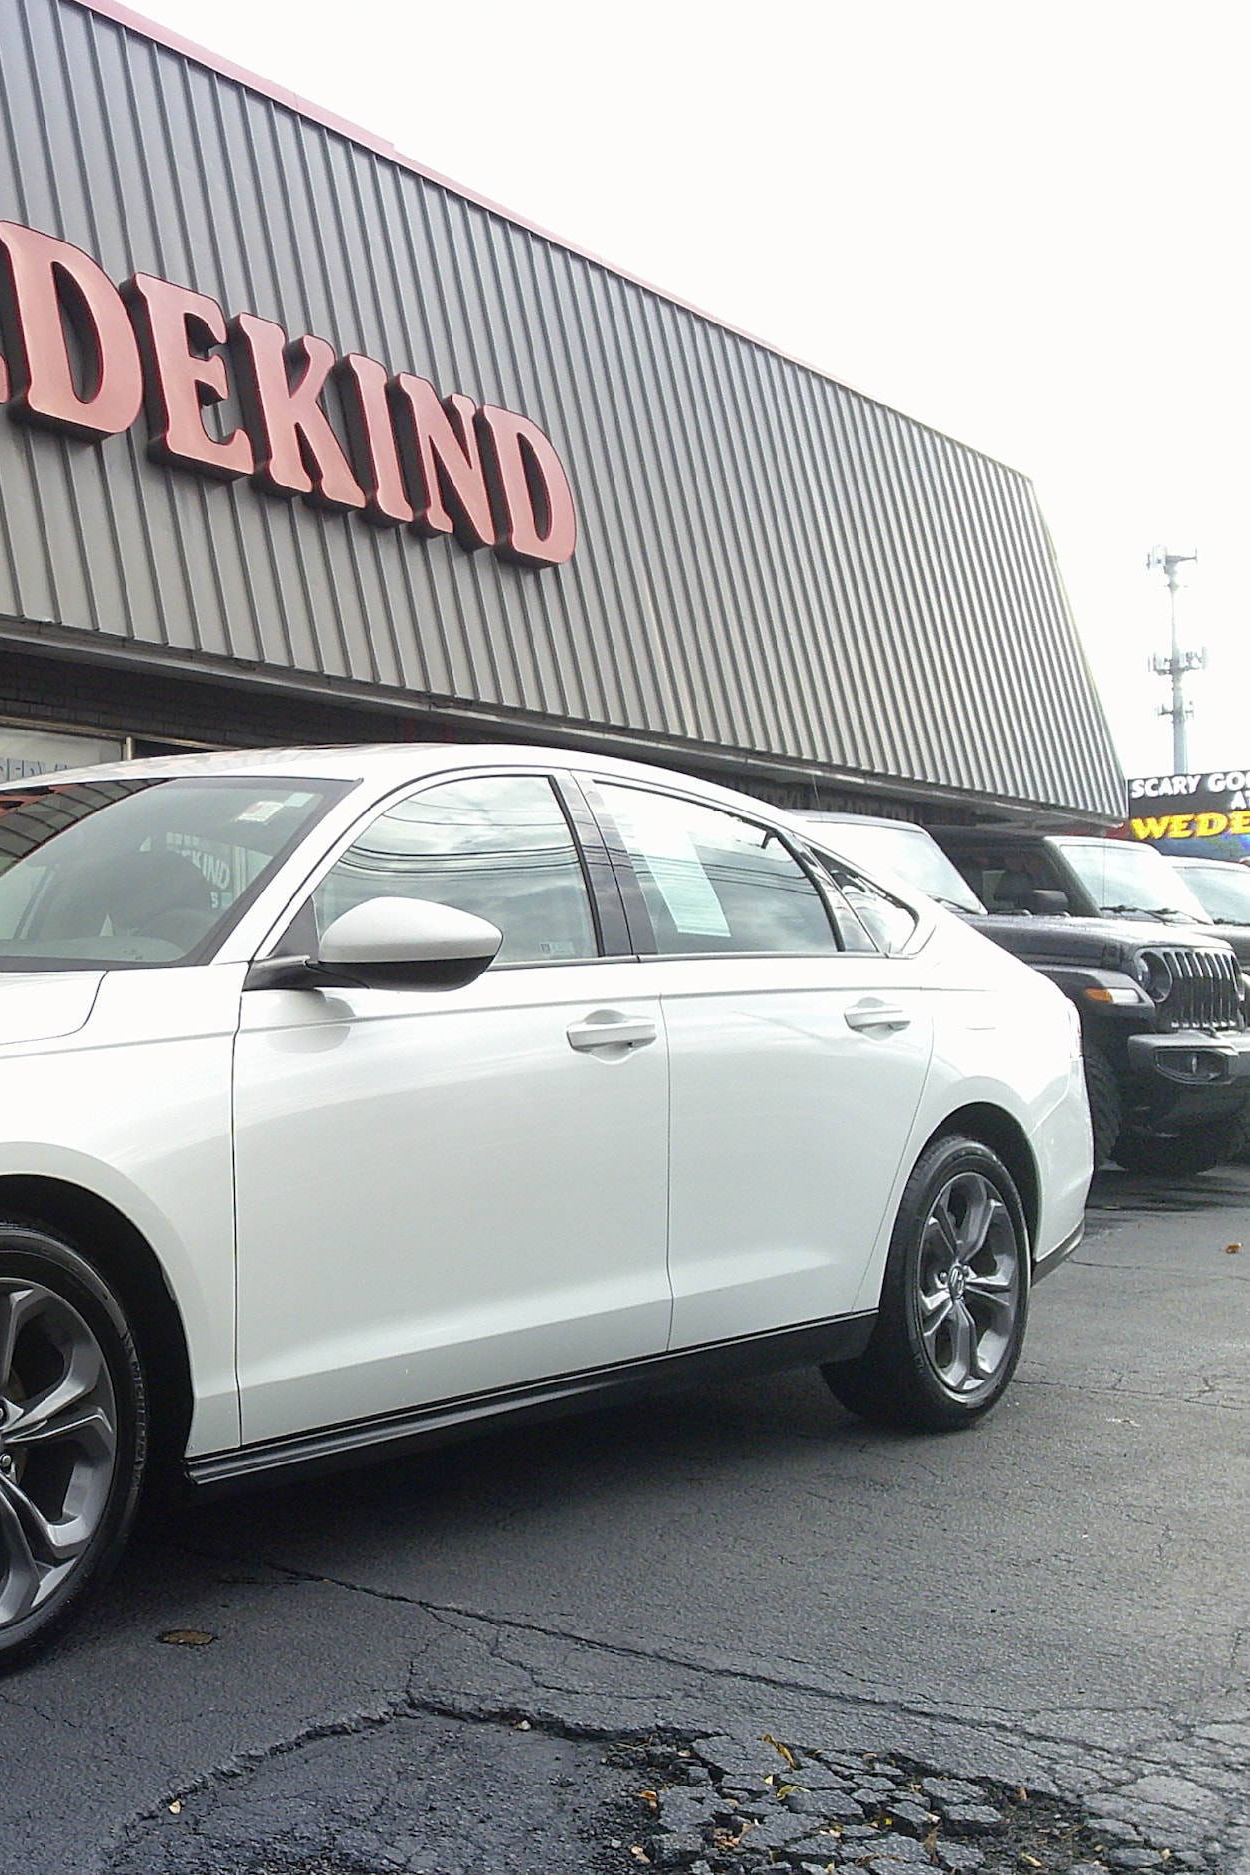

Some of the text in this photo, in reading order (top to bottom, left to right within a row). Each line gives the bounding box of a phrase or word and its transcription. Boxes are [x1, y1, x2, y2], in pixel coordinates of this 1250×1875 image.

[1131, 771, 1250, 799] SCARY GO
[1131, 810, 1250, 840] WEDE
